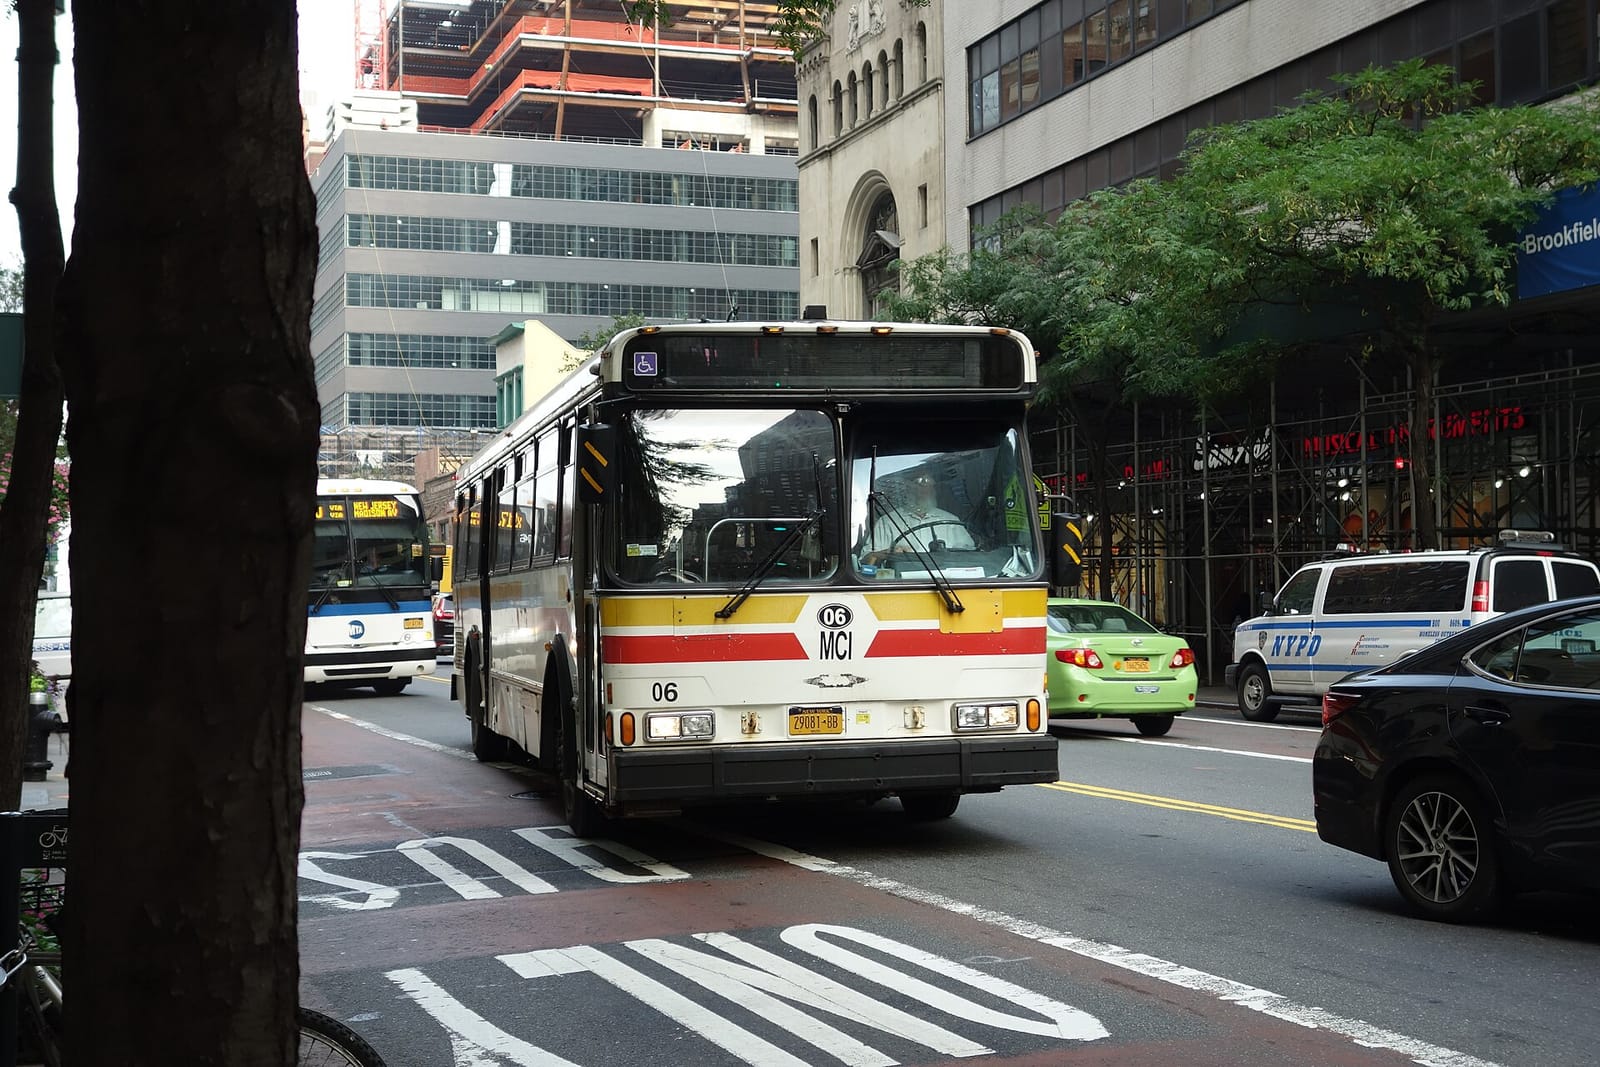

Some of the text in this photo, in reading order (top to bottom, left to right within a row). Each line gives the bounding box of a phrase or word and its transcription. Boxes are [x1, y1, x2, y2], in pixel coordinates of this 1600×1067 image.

[353, 501, 368, 510] NEW
[371, 501, 397, 510] JERSEY
[353, 509, 386, 518] MADISON
[823, 607, 847, 626] 06
[819, 631, 852, 660] MCI
[1271, 635, 1322, 657] NYPD
[652, 682, 678, 702] 06
